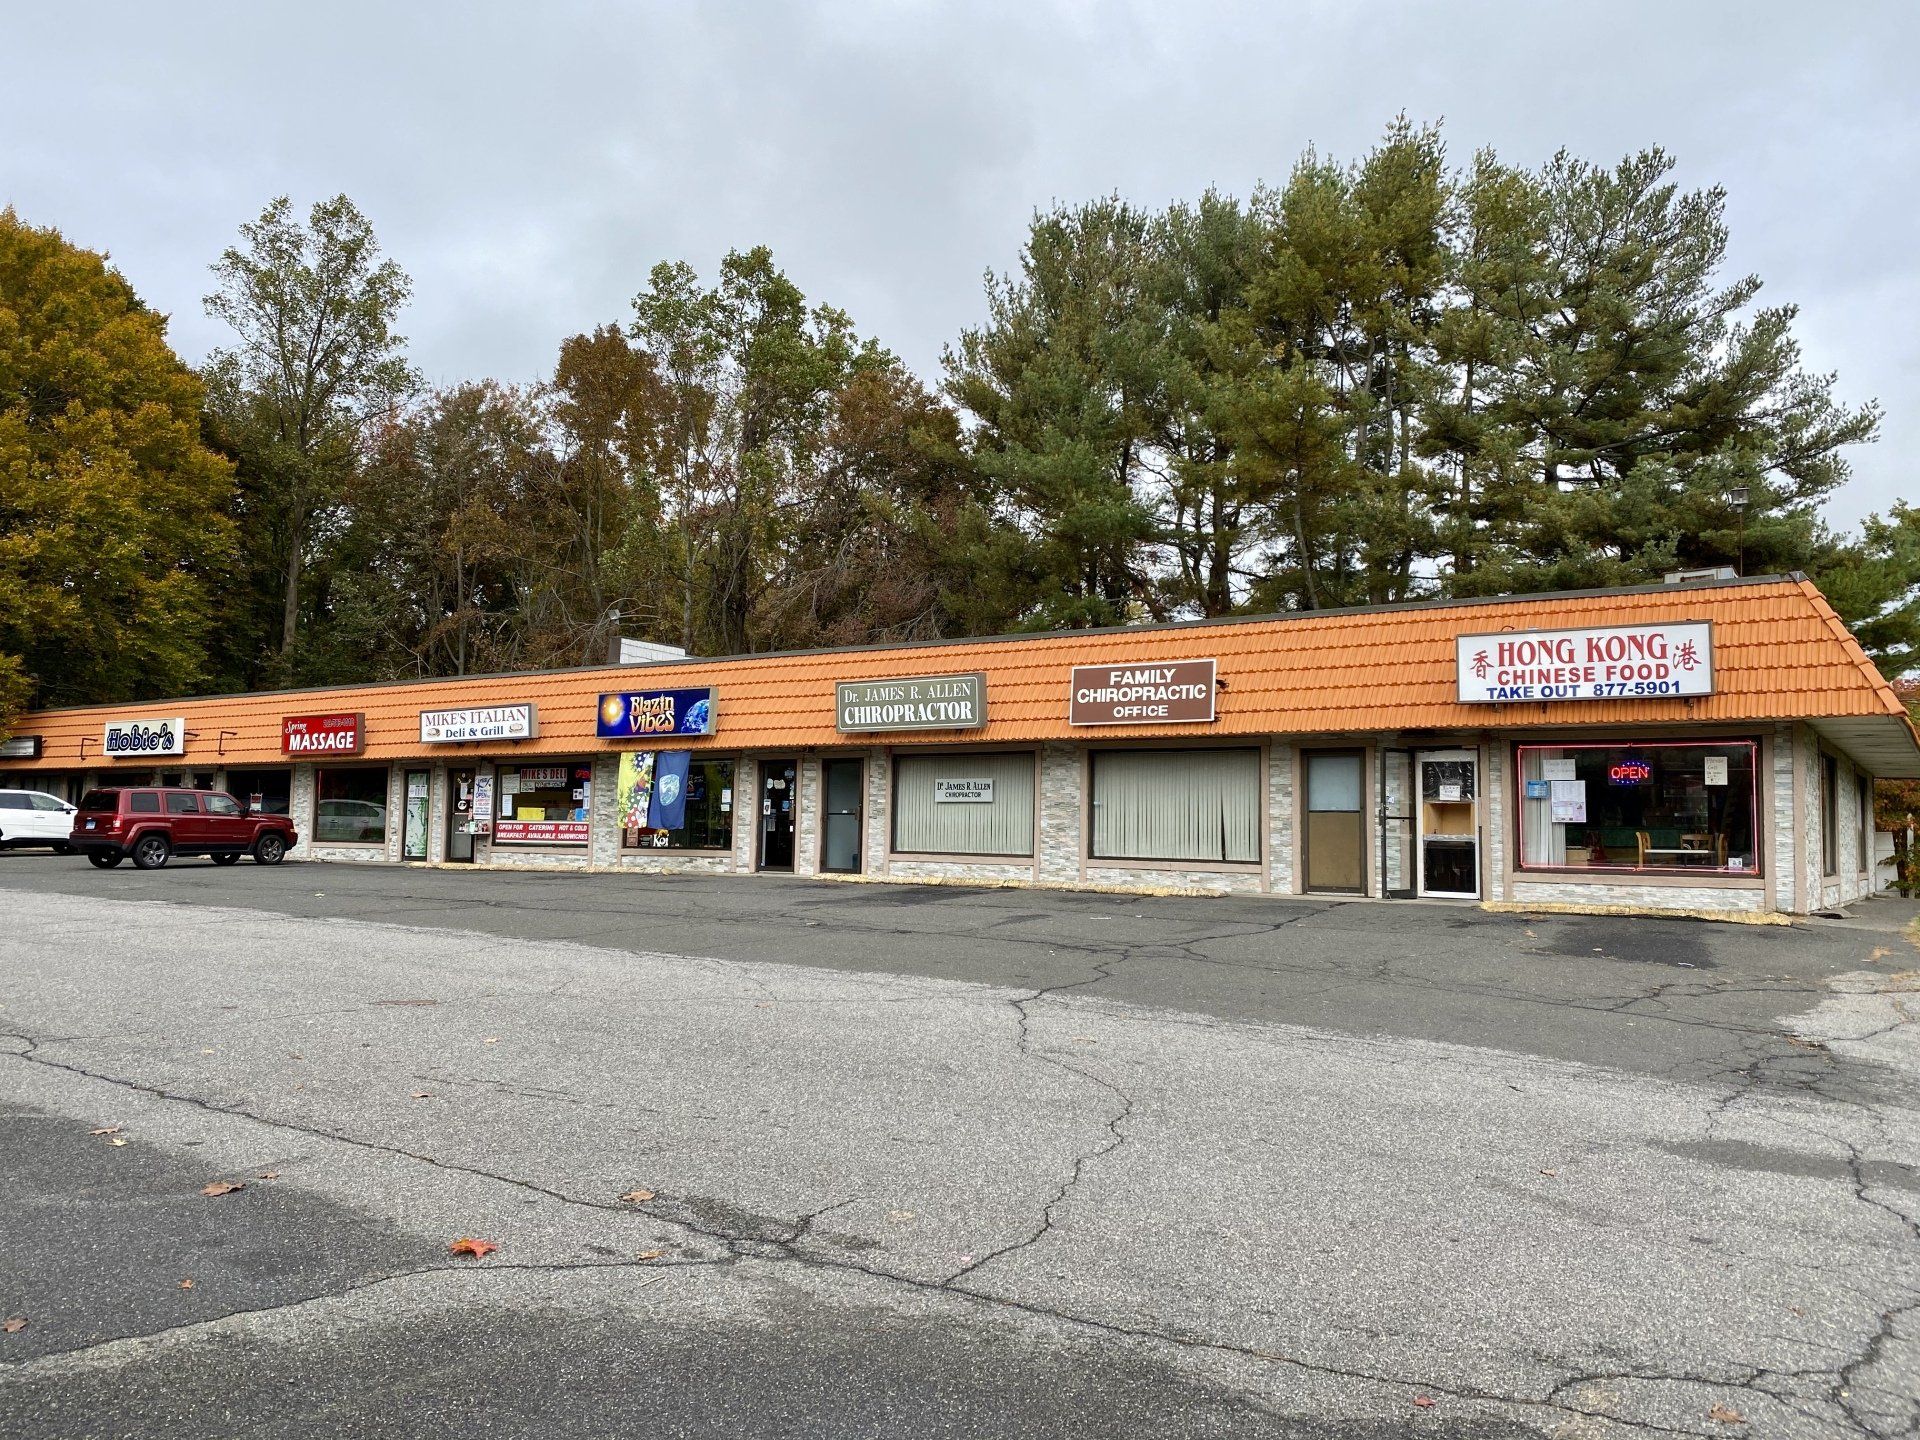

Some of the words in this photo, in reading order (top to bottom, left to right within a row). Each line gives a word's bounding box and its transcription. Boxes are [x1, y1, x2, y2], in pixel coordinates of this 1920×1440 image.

[1498, 638, 1575, 667] HONG
[1586, 633, 1668, 663] KONG
[1673, 639, 1702, 672] 港
[1470, 650, 1494, 680] 香
[1497, 666, 1596, 686] CHINESE
[1606, 663, 1670, 681] FOOD
[1109, 668, 1177, 686] FAMILY
[844, 690, 859, 703] Dr.
[865, 686, 905, 702] JAMES
[910, 686, 921, 700] R.
[927, 682, 971, 699] ALLEN
[1076, 684, 1207, 704] CHIROPRACTIC
[1486, 686, 1535, 700] TAKE
[1541, 684, 1580, 698] OUT
[1593, 680, 1681, 697] 877-5901
[629, 693, 675, 717] Blazin
[844, 700, 973, 725] CHIROPRACTOR
[1113, 705, 1169, 718] OFFICE
[285, 720, 308, 734] Spring
[425, 712, 467, 727] MIKE'S
[470, 708, 527, 724] ITALIAN
[106, 722, 175, 751] Hobie's
[288, 731, 355, 751] MASSAGE
[445, 728, 466, 738] Deli
[468, 727, 478, 737] &
[480, 725, 504, 736] Grill
[521, 769, 548, 780] MIKE'S
[549, 768, 567, 780] DELI
[1611, 766, 1649, 779] OPEN
[945, 781, 966, 791] JAMES
[972, 781, 991, 791] ALLEN
[527, 832, 556, 840] AVAILABLE
[557, 833, 588, 841] SANDWICHES
[653, 834, 669, 848] Koi
